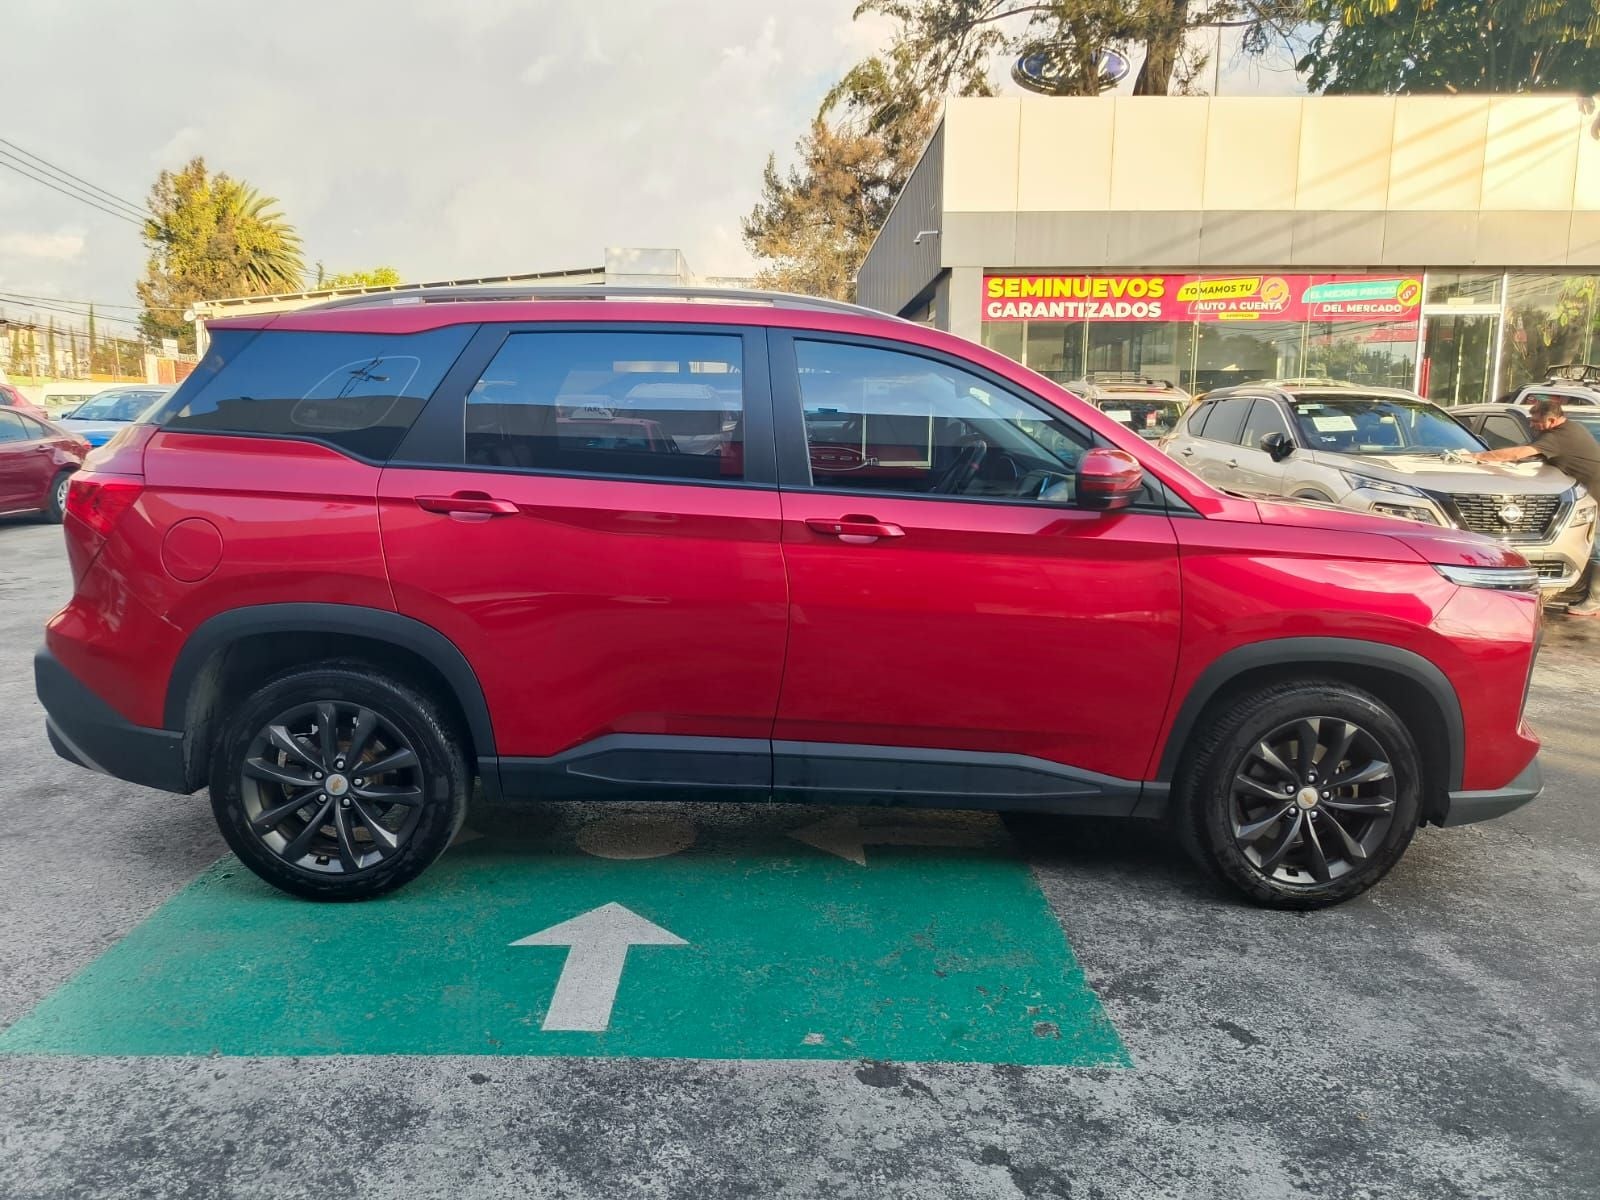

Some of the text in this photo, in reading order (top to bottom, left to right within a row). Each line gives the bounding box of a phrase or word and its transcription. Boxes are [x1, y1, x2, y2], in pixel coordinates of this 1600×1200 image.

[987, 278, 1164, 298] SEMINUEVOS
[1240, 283, 1252, 292] TU
[1311, 286, 1397, 299] EL MEJOR PRECIO
[987, 302, 1162, 318] GARANTIZADOS
[1195, 301, 1282, 311] AUTO A CUENTA
[1323, 304, 1402, 313] DEL MERCADO
